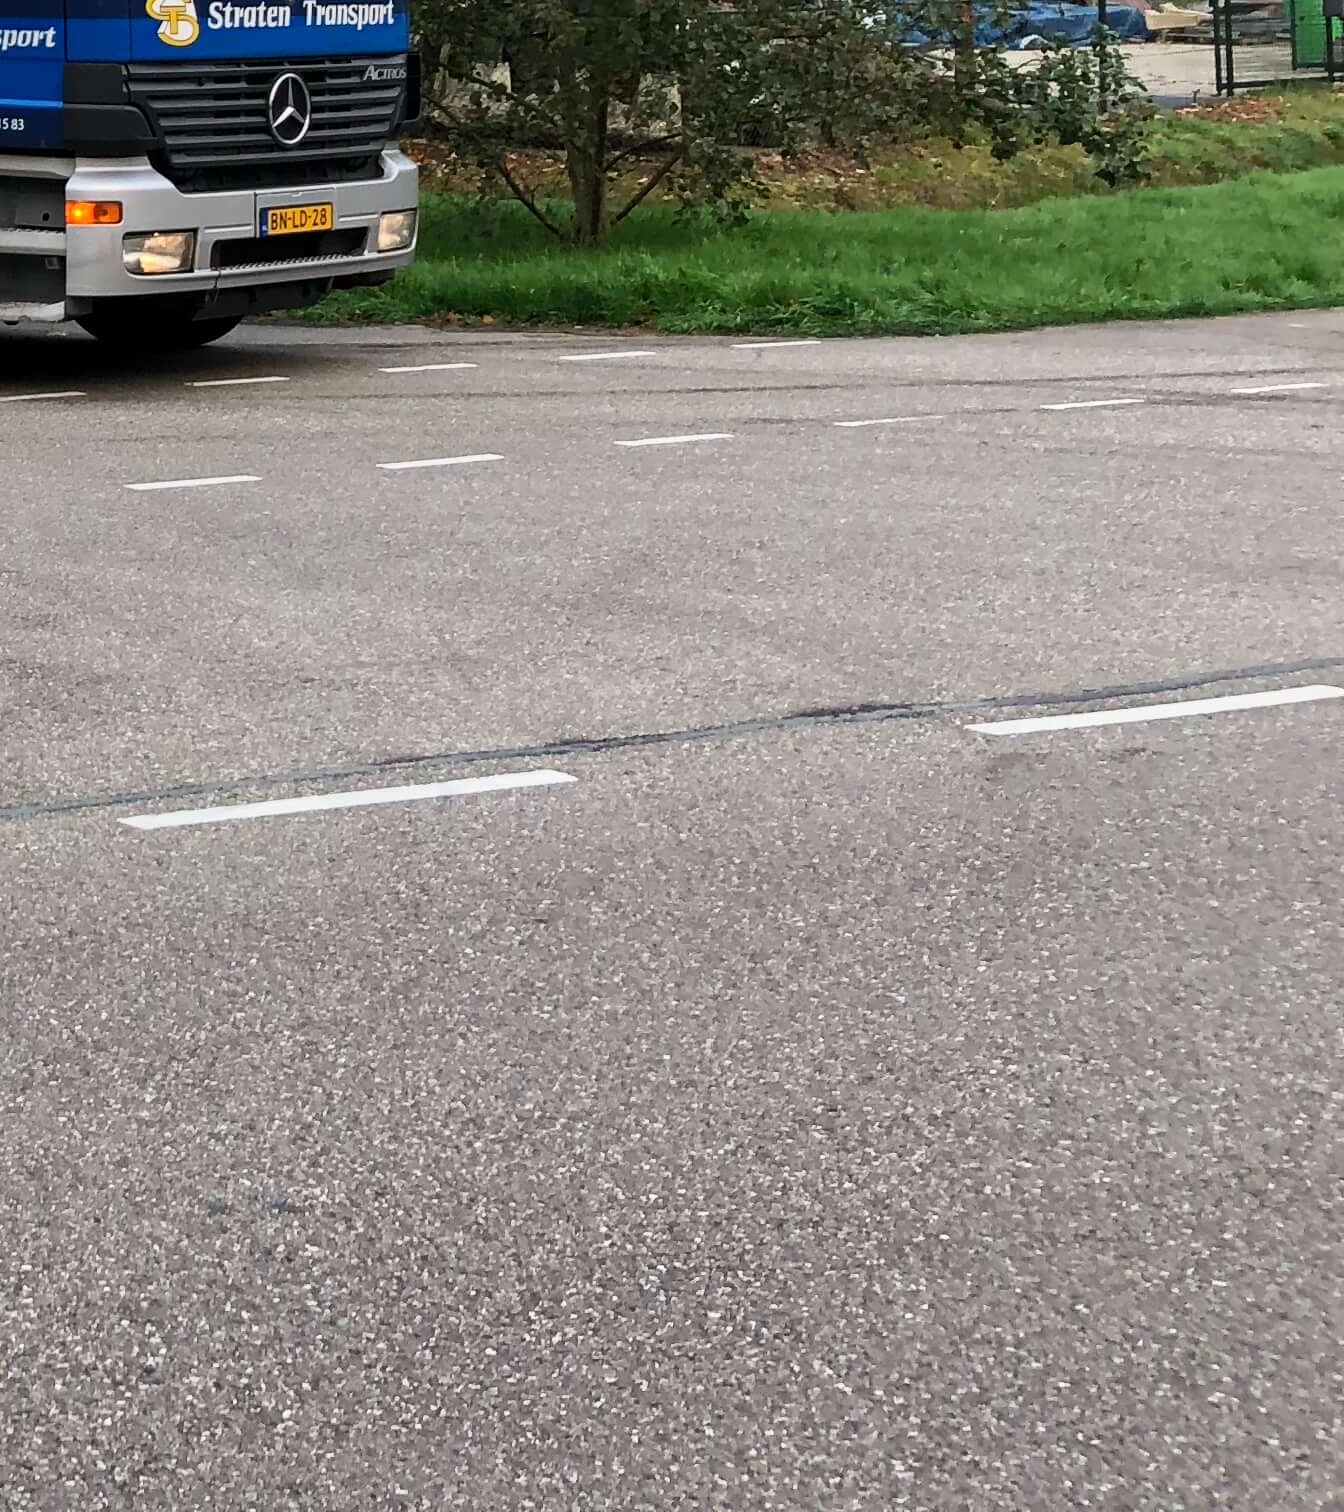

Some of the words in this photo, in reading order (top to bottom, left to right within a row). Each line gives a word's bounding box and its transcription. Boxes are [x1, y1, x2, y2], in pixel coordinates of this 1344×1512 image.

[207, 0, 291, 30] Straten
[10, 118, 25, 130] 83
[270, 207, 328, 231] BN-LD-28
